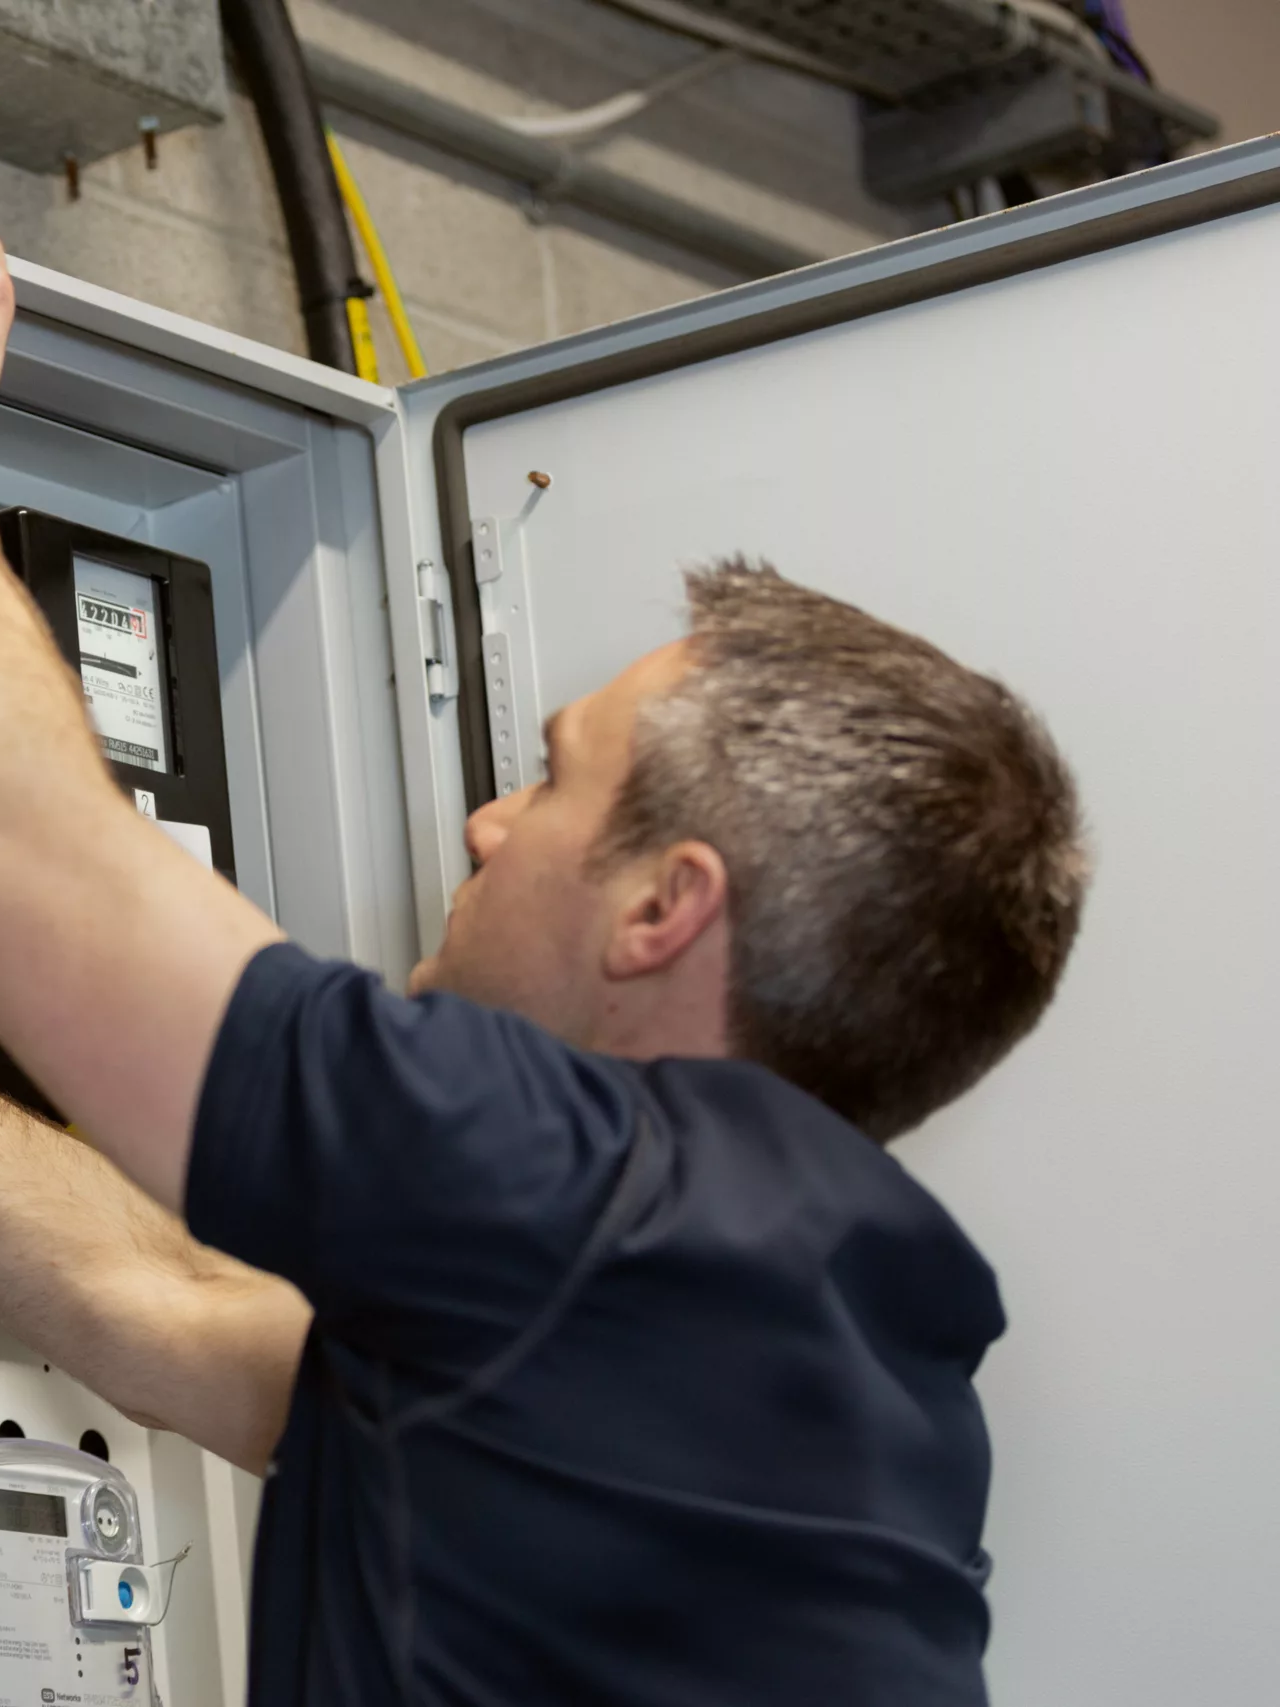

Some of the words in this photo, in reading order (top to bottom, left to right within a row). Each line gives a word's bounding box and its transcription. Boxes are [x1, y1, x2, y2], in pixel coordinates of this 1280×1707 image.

[141, 794, 150, 816] 2
[124, 1647, 141, 1685] 5
[56, 1692, 81, 1702] Networks
